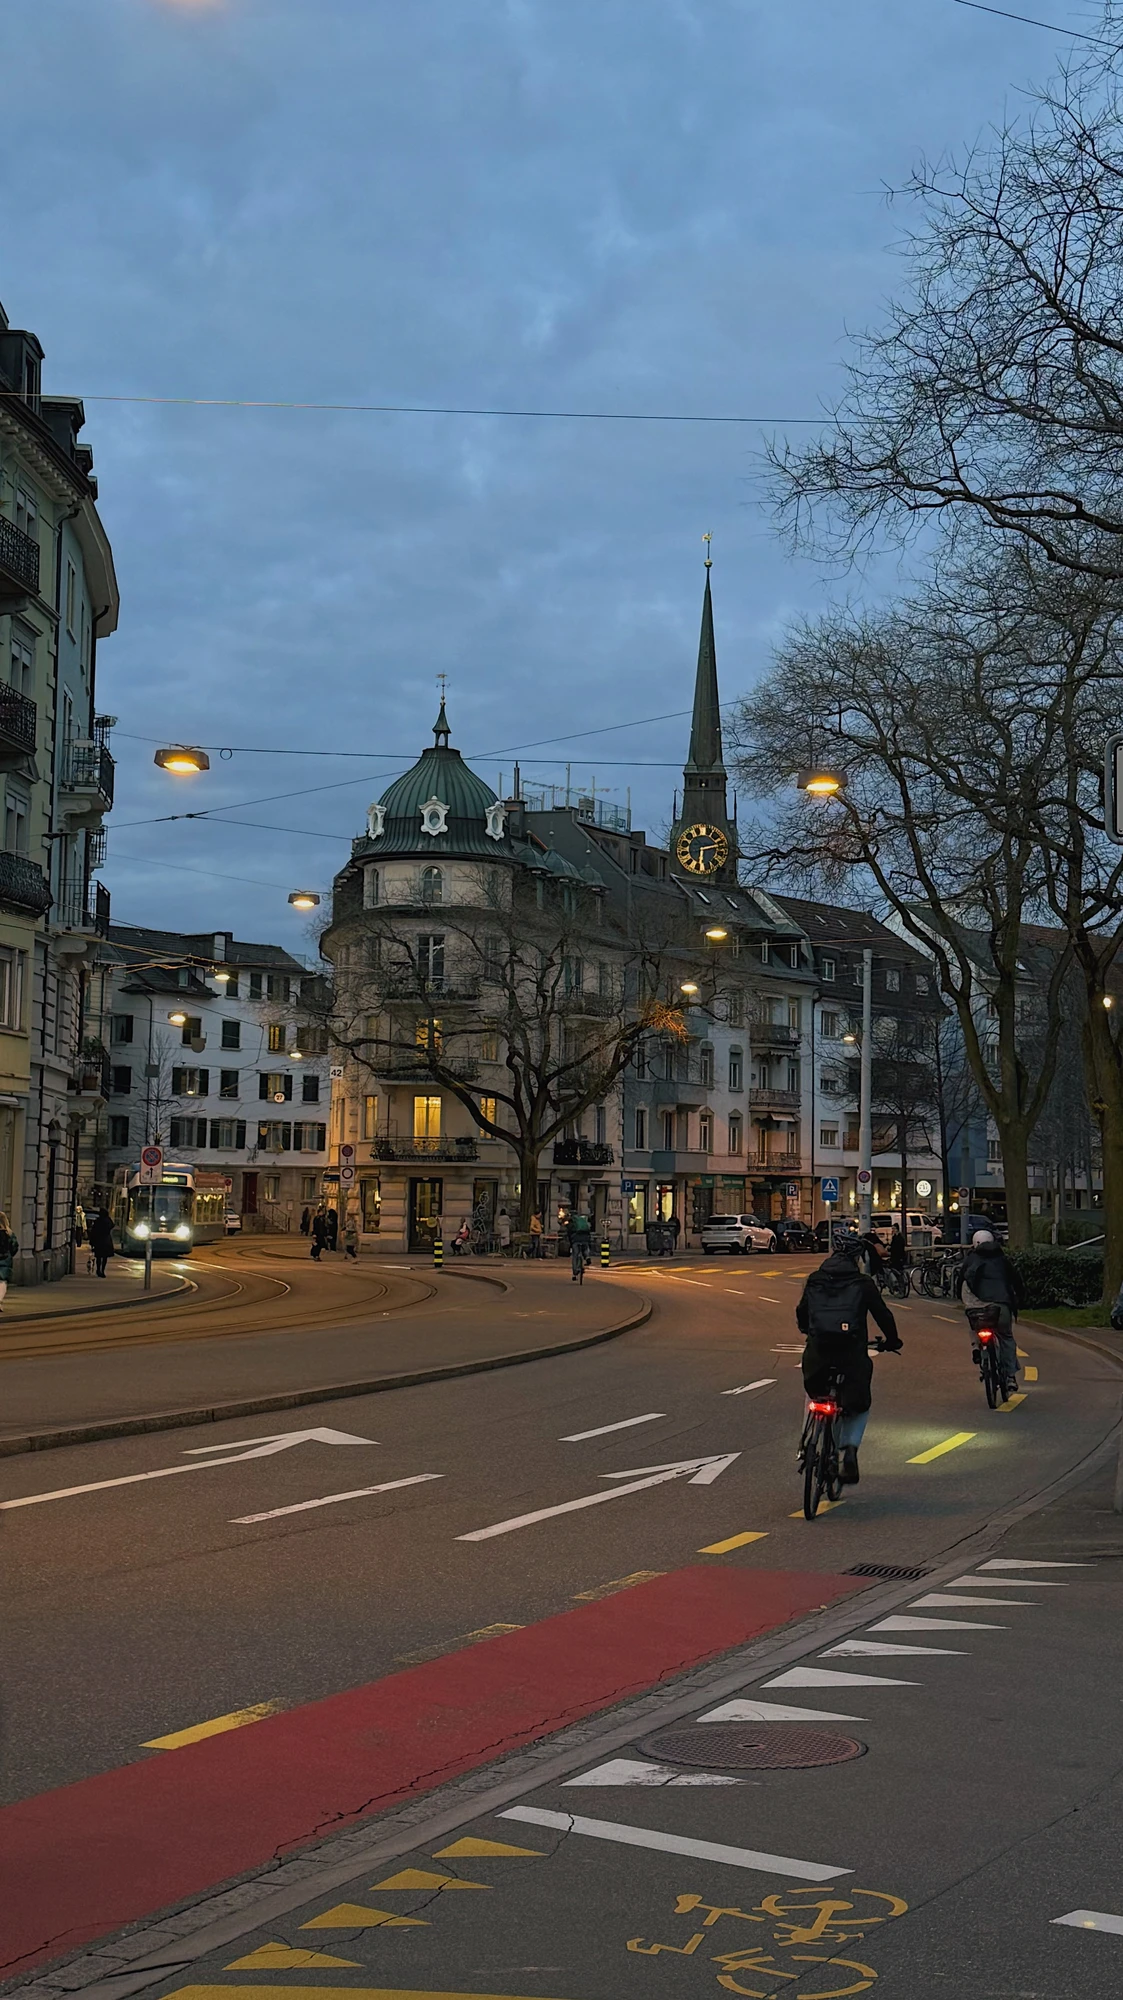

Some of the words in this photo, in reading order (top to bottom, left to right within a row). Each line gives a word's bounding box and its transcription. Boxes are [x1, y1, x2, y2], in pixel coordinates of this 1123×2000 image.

[331, 1069, 342, 1077] 42
[625, 1181, 631, 1190] P
[789, 1186, 795, 1194] P
